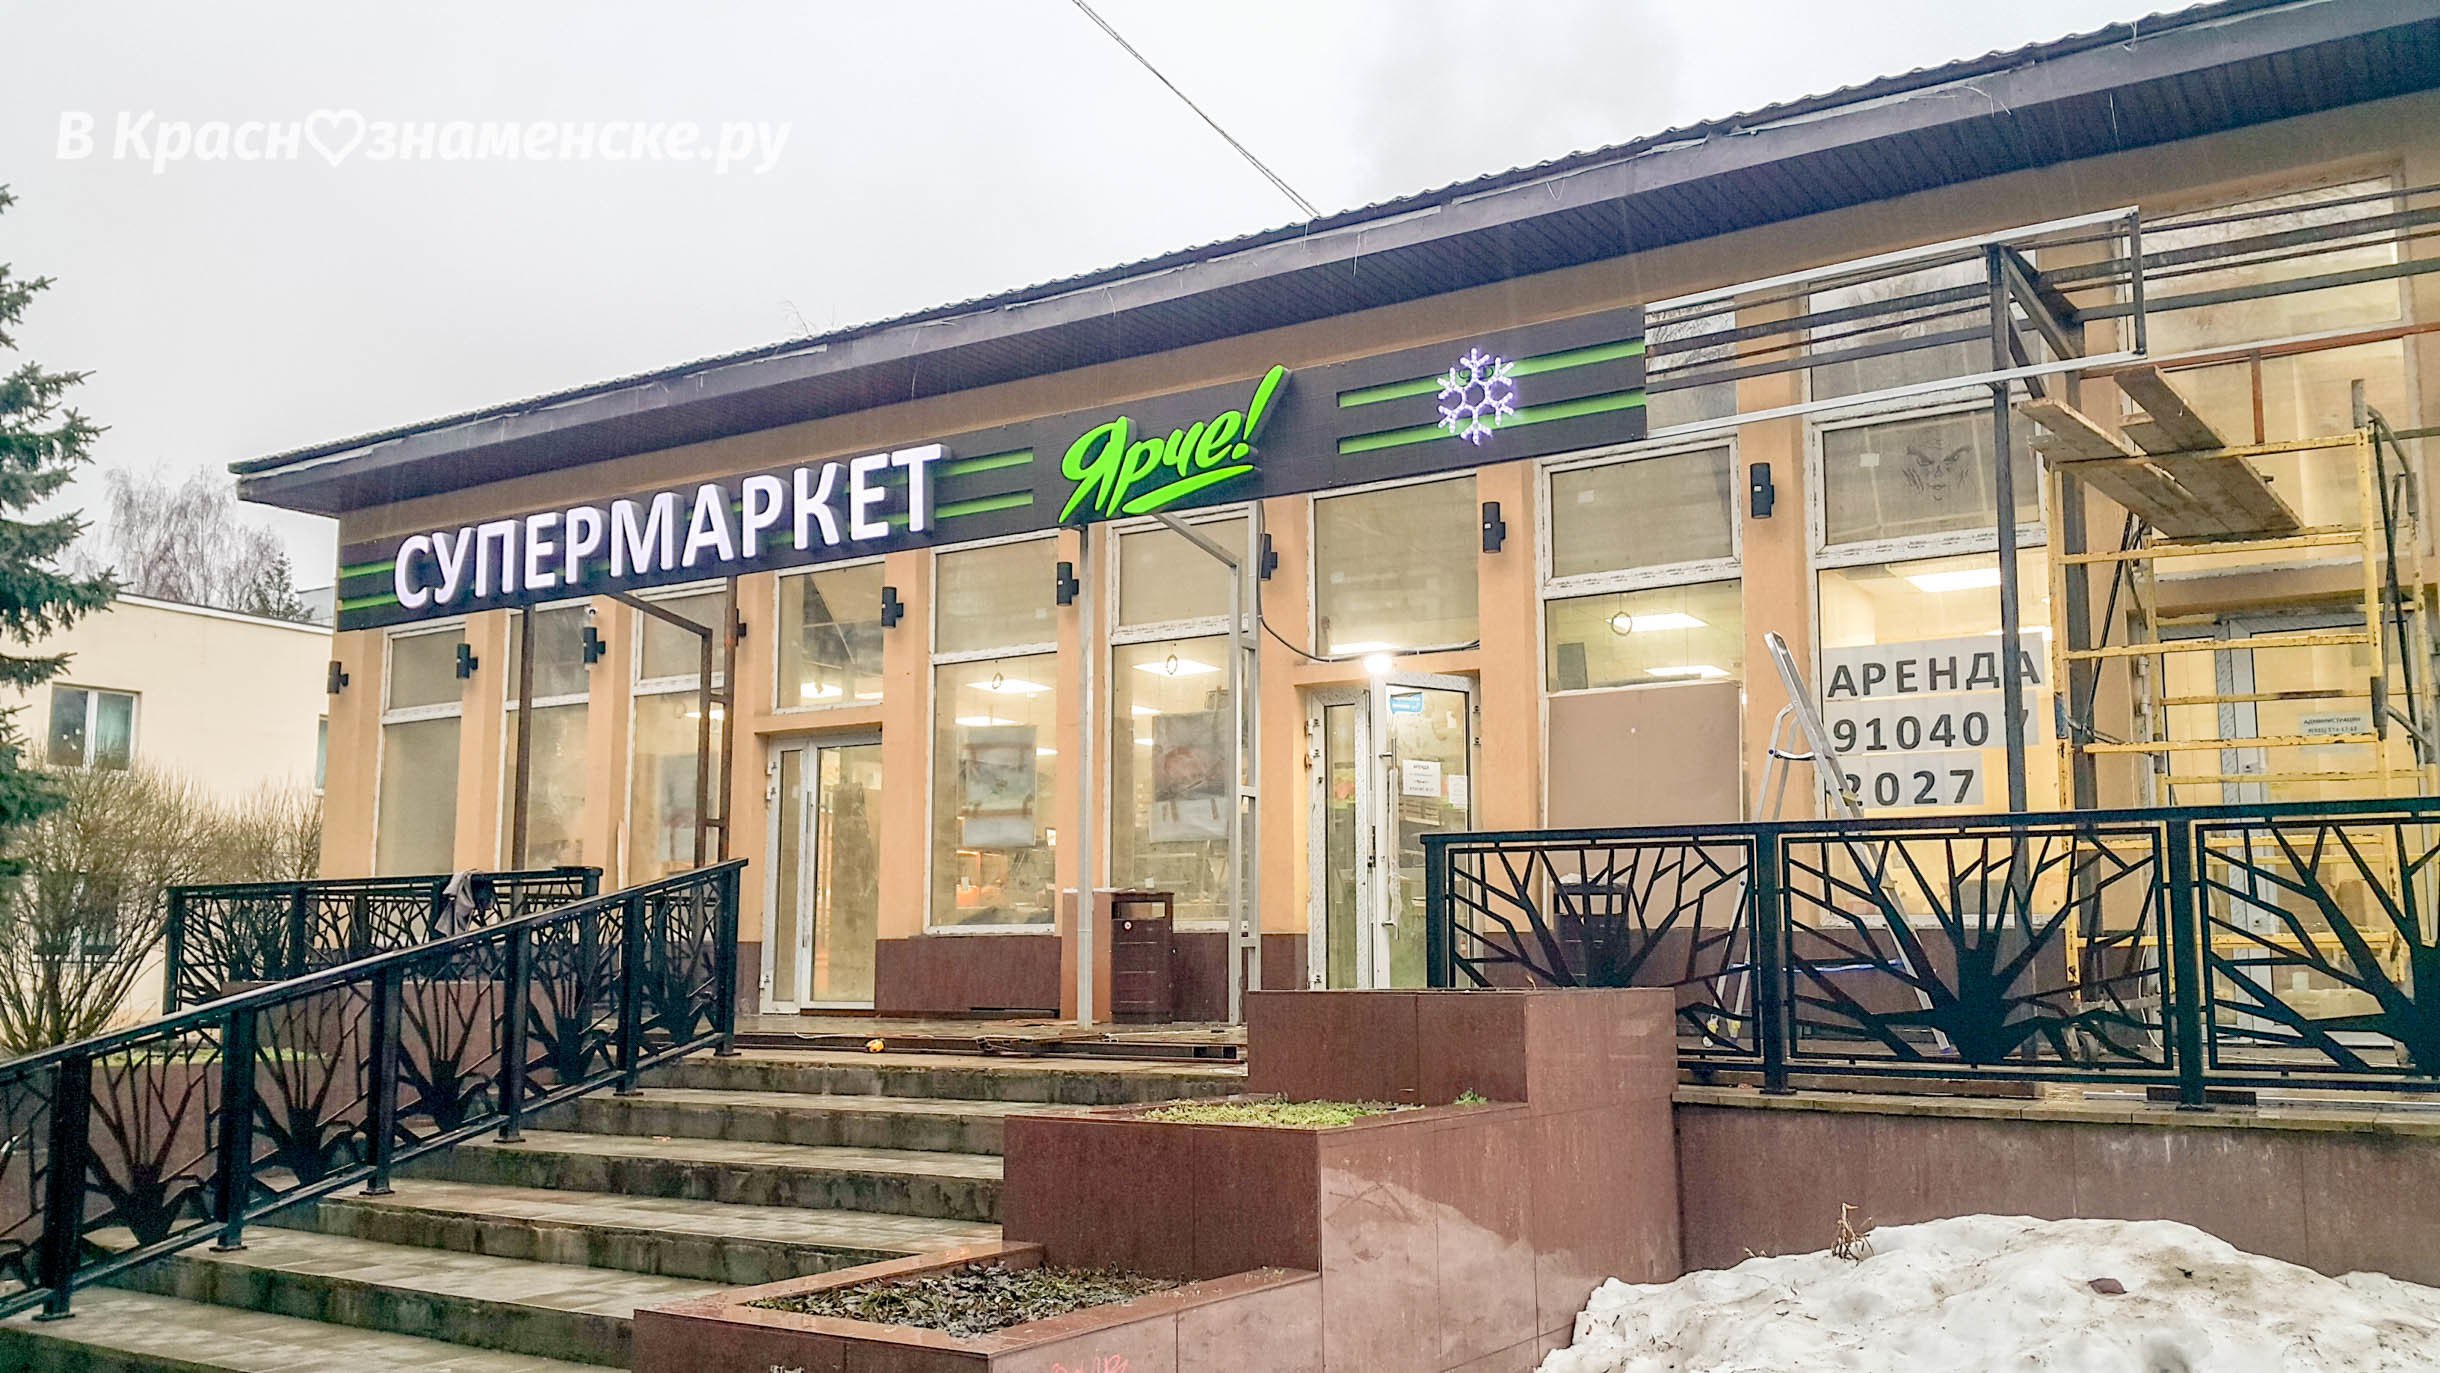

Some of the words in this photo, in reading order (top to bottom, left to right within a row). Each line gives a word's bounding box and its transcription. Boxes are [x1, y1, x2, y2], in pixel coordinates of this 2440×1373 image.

[1058, 364, 1288, 524] Ярче!
[393, 443, 946, 610] СУПЕРМАРКЕТ
[1827, 650, 2041, 698] АРЕНДА
[1833, 709, 2029, 752] 91040
